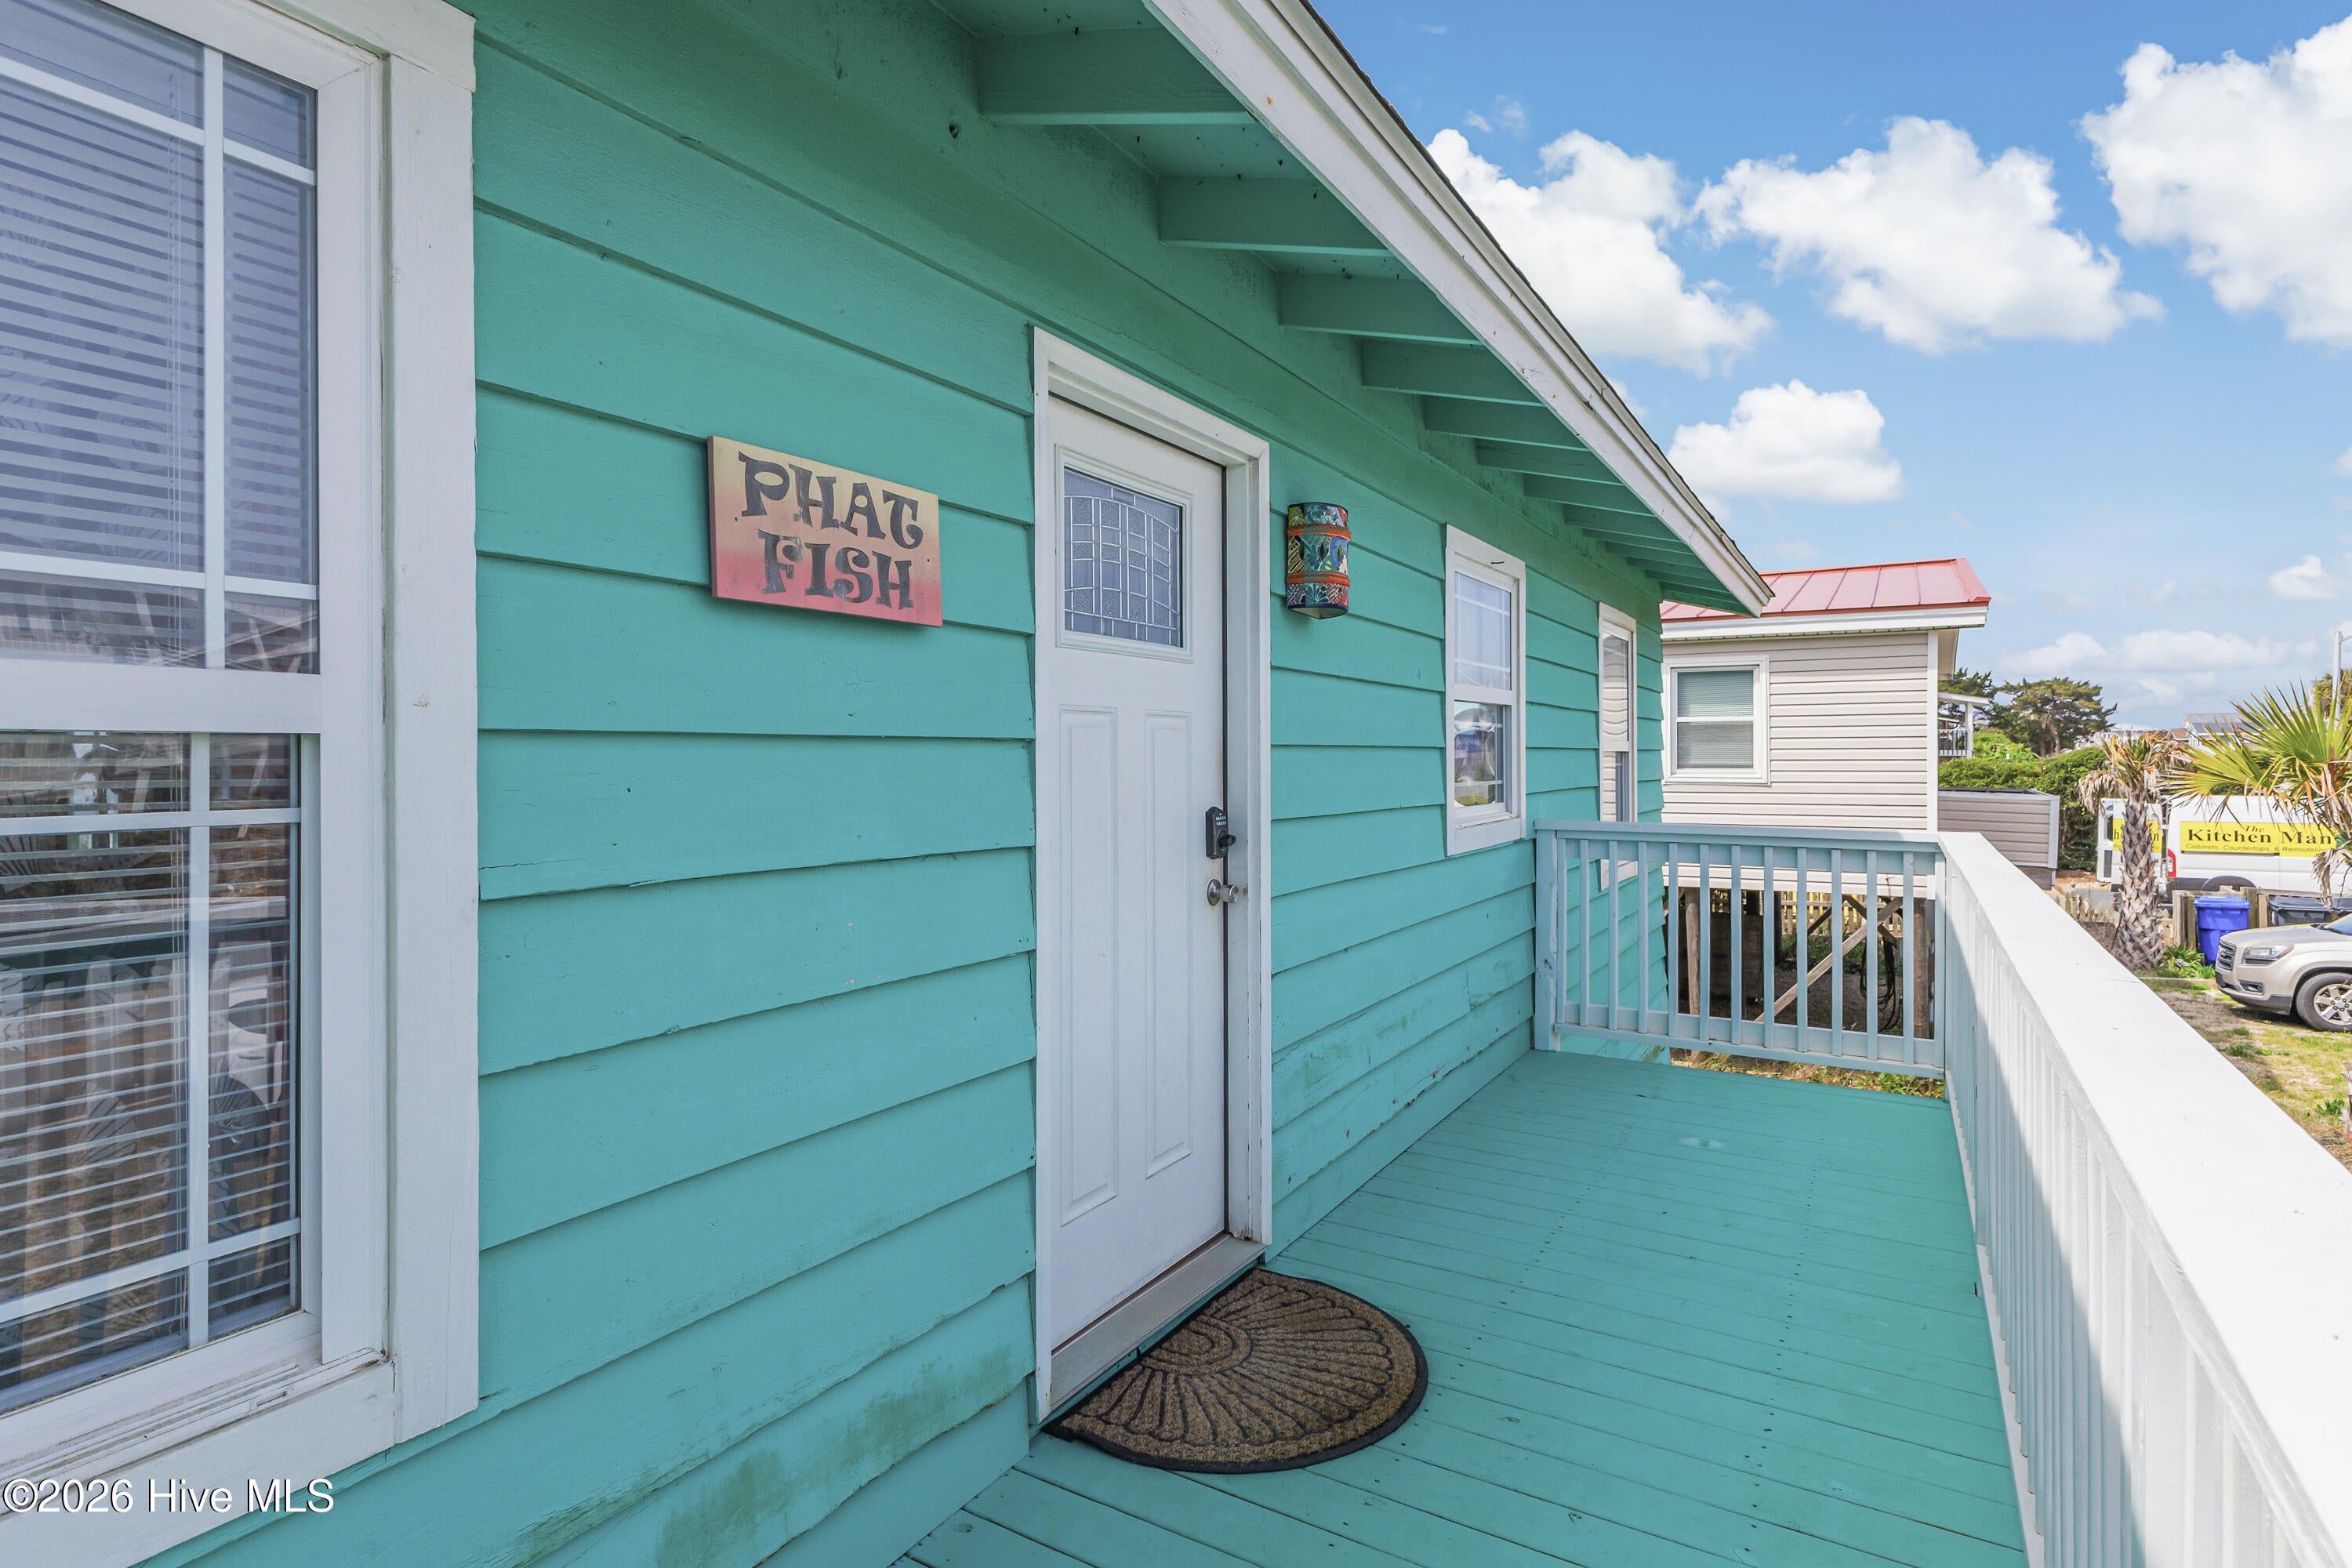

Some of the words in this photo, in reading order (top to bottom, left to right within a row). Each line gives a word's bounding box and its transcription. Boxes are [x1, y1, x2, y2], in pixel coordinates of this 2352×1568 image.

[738, 451, 924, 550] PHAT
[758, 529, 914, 610] FISH
[2188, 829, 2271, 843] Kitchen
[2281, 831, 2332, 844] Man
[2223, 844, 2272, 853] Countertops,
